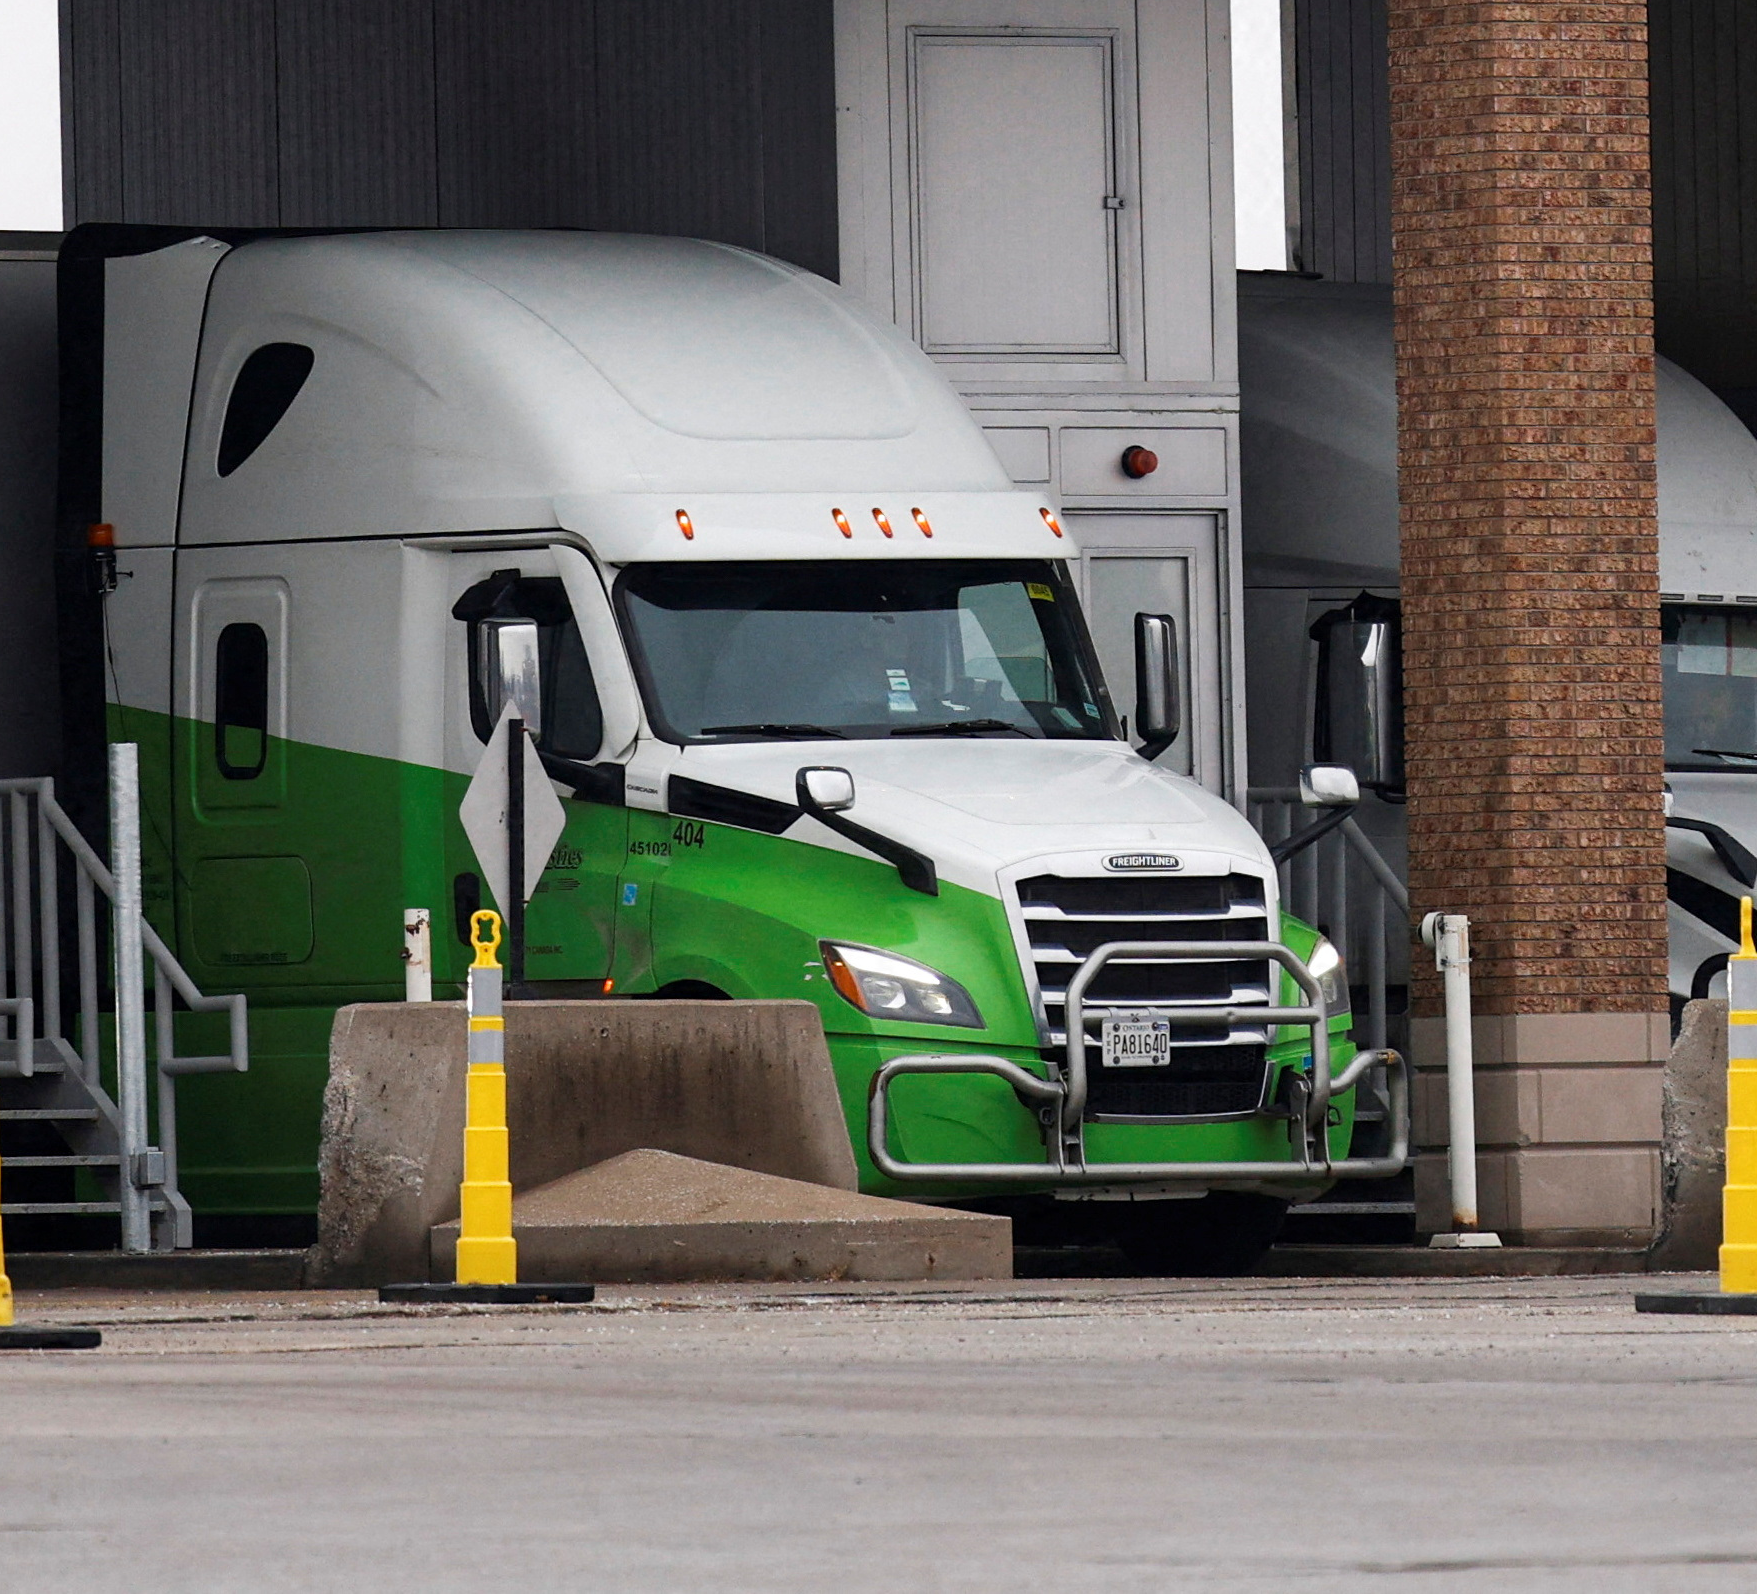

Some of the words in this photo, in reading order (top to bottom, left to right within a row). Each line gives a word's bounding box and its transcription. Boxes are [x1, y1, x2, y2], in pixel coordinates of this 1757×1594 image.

[672, 820, 705, 850] 404
[1111, 855, 1177, 867] FREIGHTLINER
[1113, 1033, 1168, 1055] PA81640
